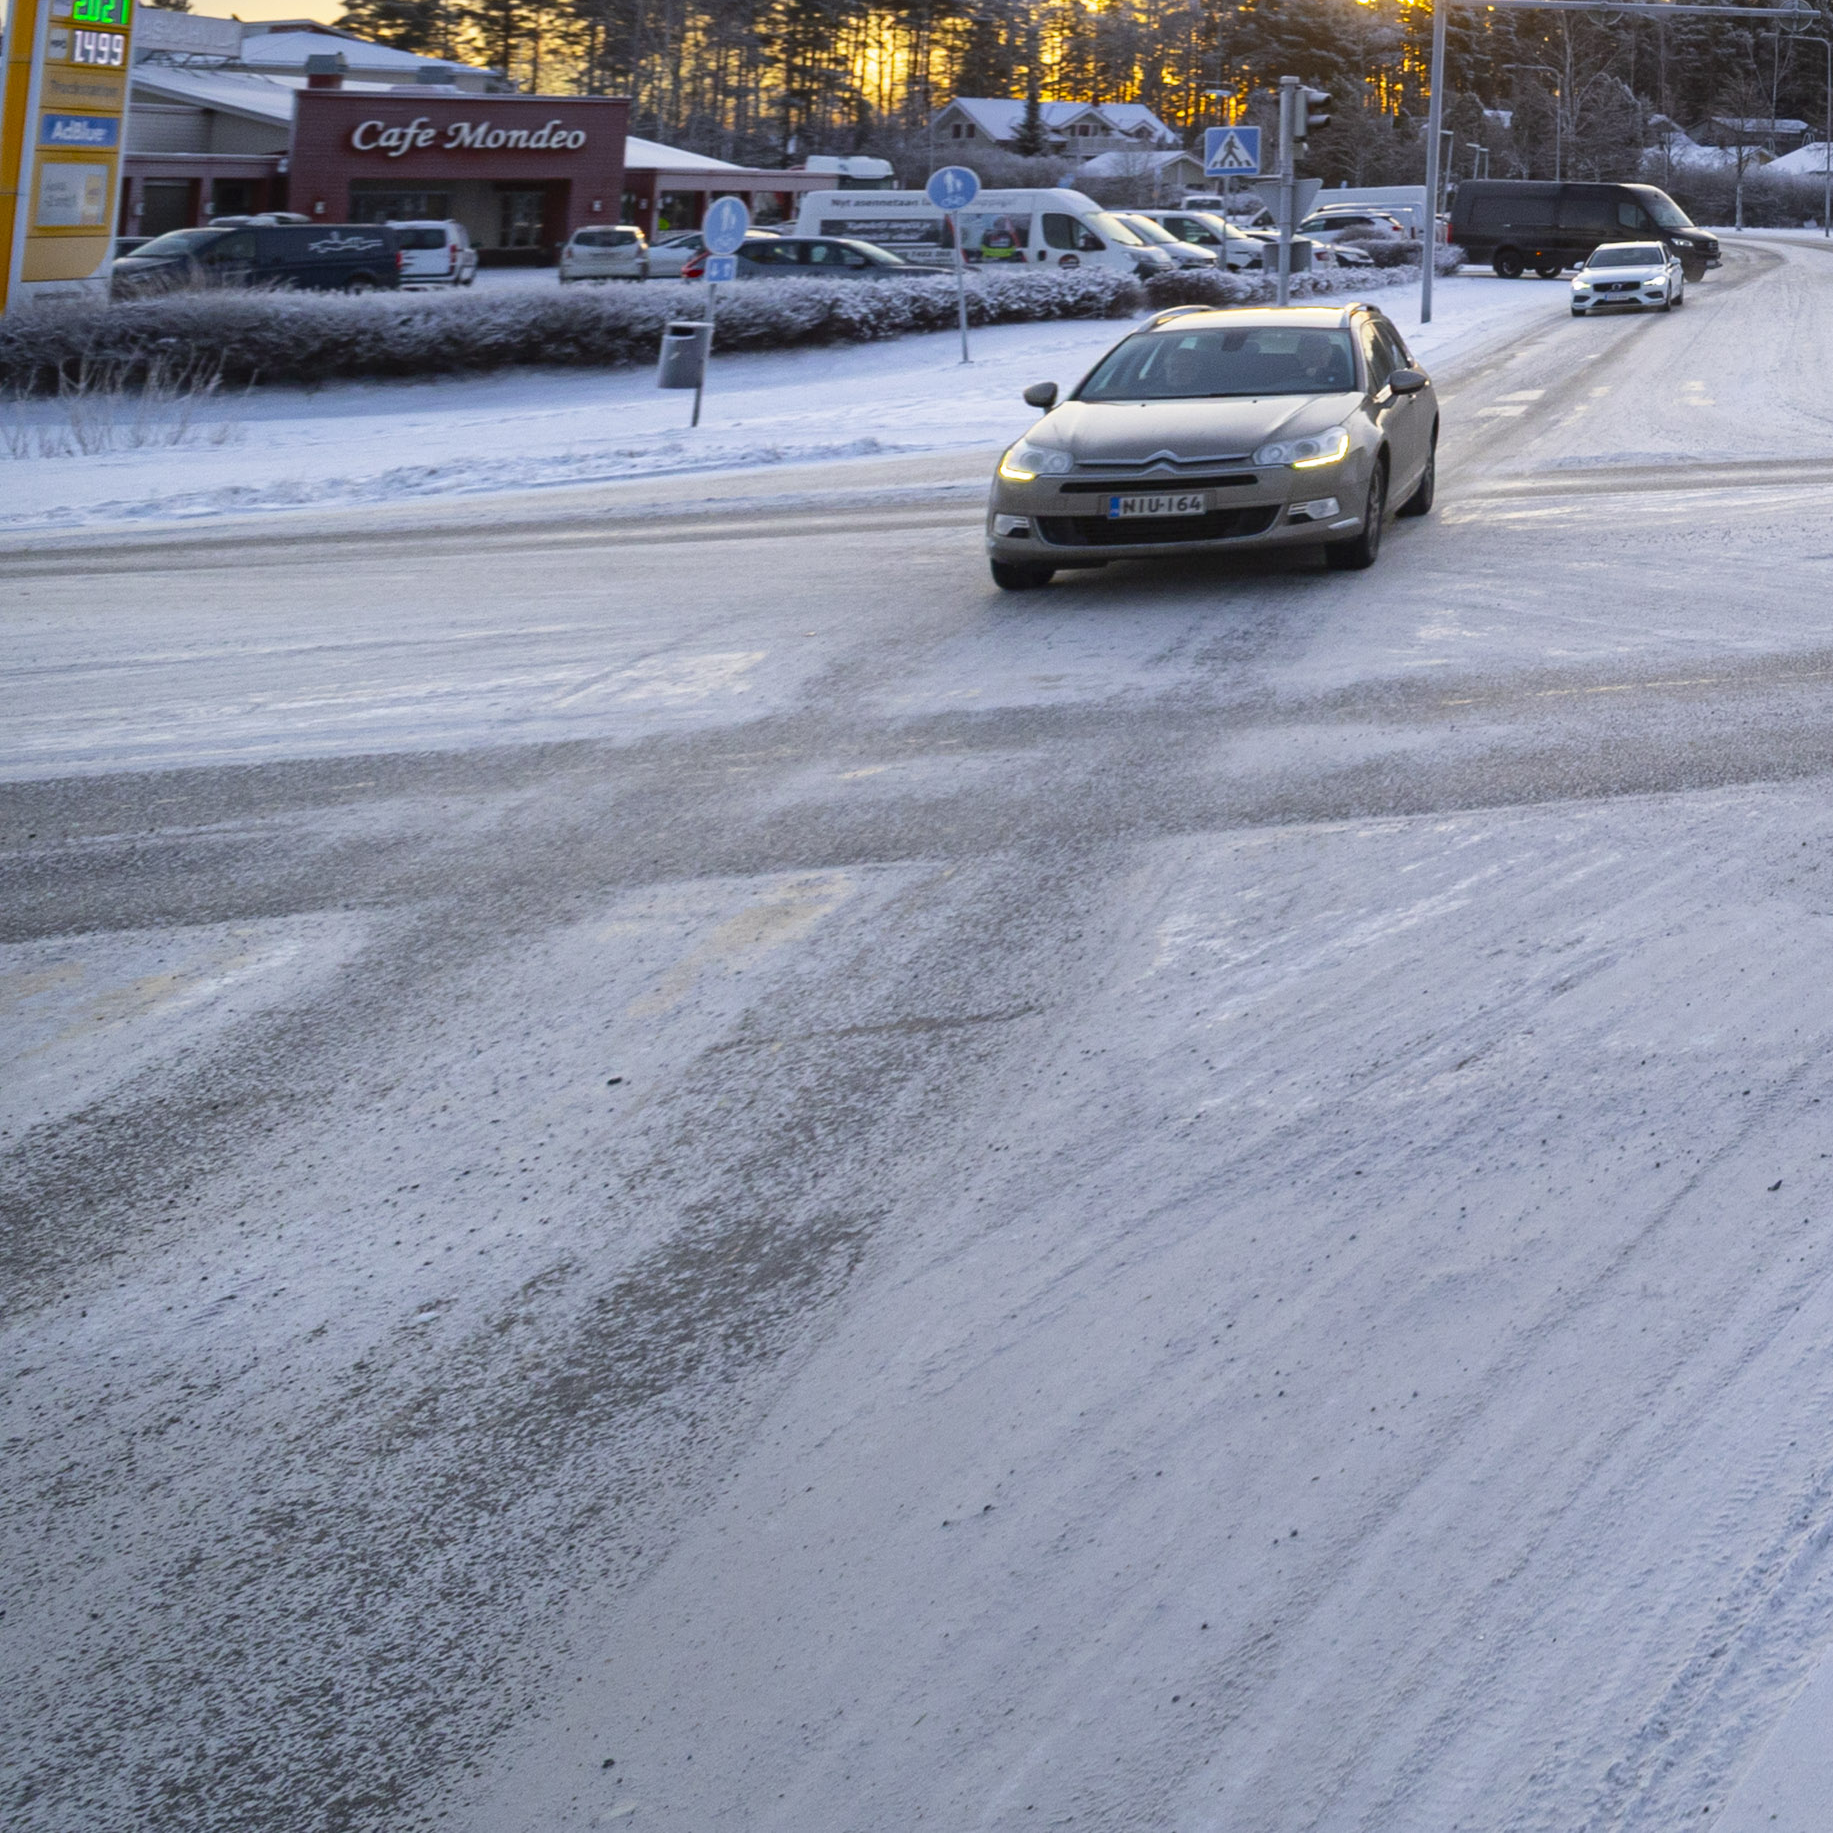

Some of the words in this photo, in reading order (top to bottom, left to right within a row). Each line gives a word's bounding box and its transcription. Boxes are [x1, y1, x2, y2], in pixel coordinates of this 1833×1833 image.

[52, 120, 107, 141] AdBlue
[352, 117, 436, 156] Cafe
[444, 120, 586, 149] Mondeo
[1123, 497, 1201, 514] NIU-164
